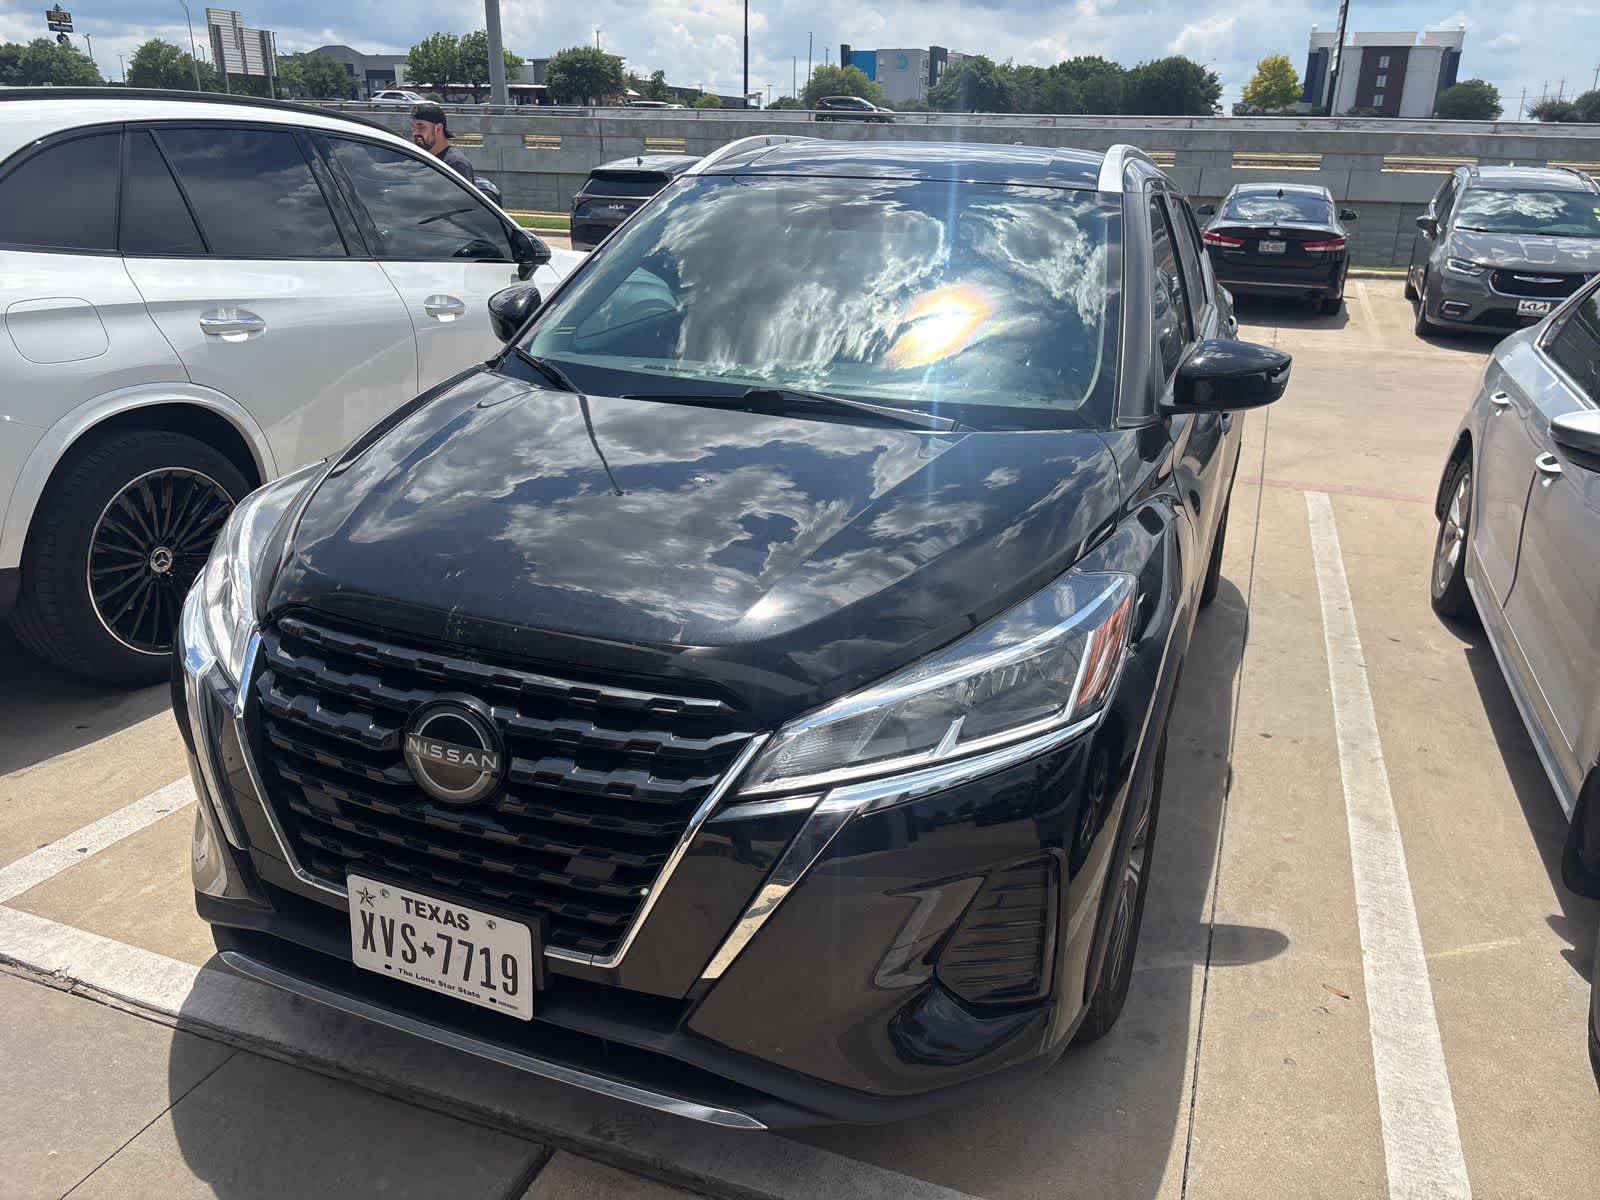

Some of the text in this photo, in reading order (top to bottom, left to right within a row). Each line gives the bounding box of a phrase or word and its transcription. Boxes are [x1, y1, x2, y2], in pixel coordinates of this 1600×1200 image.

[408, 737, 497, 769] NISSAN
[400, 895, 471, 931] TEXAS
[398, 967, 481, 999] The Lone Star State
